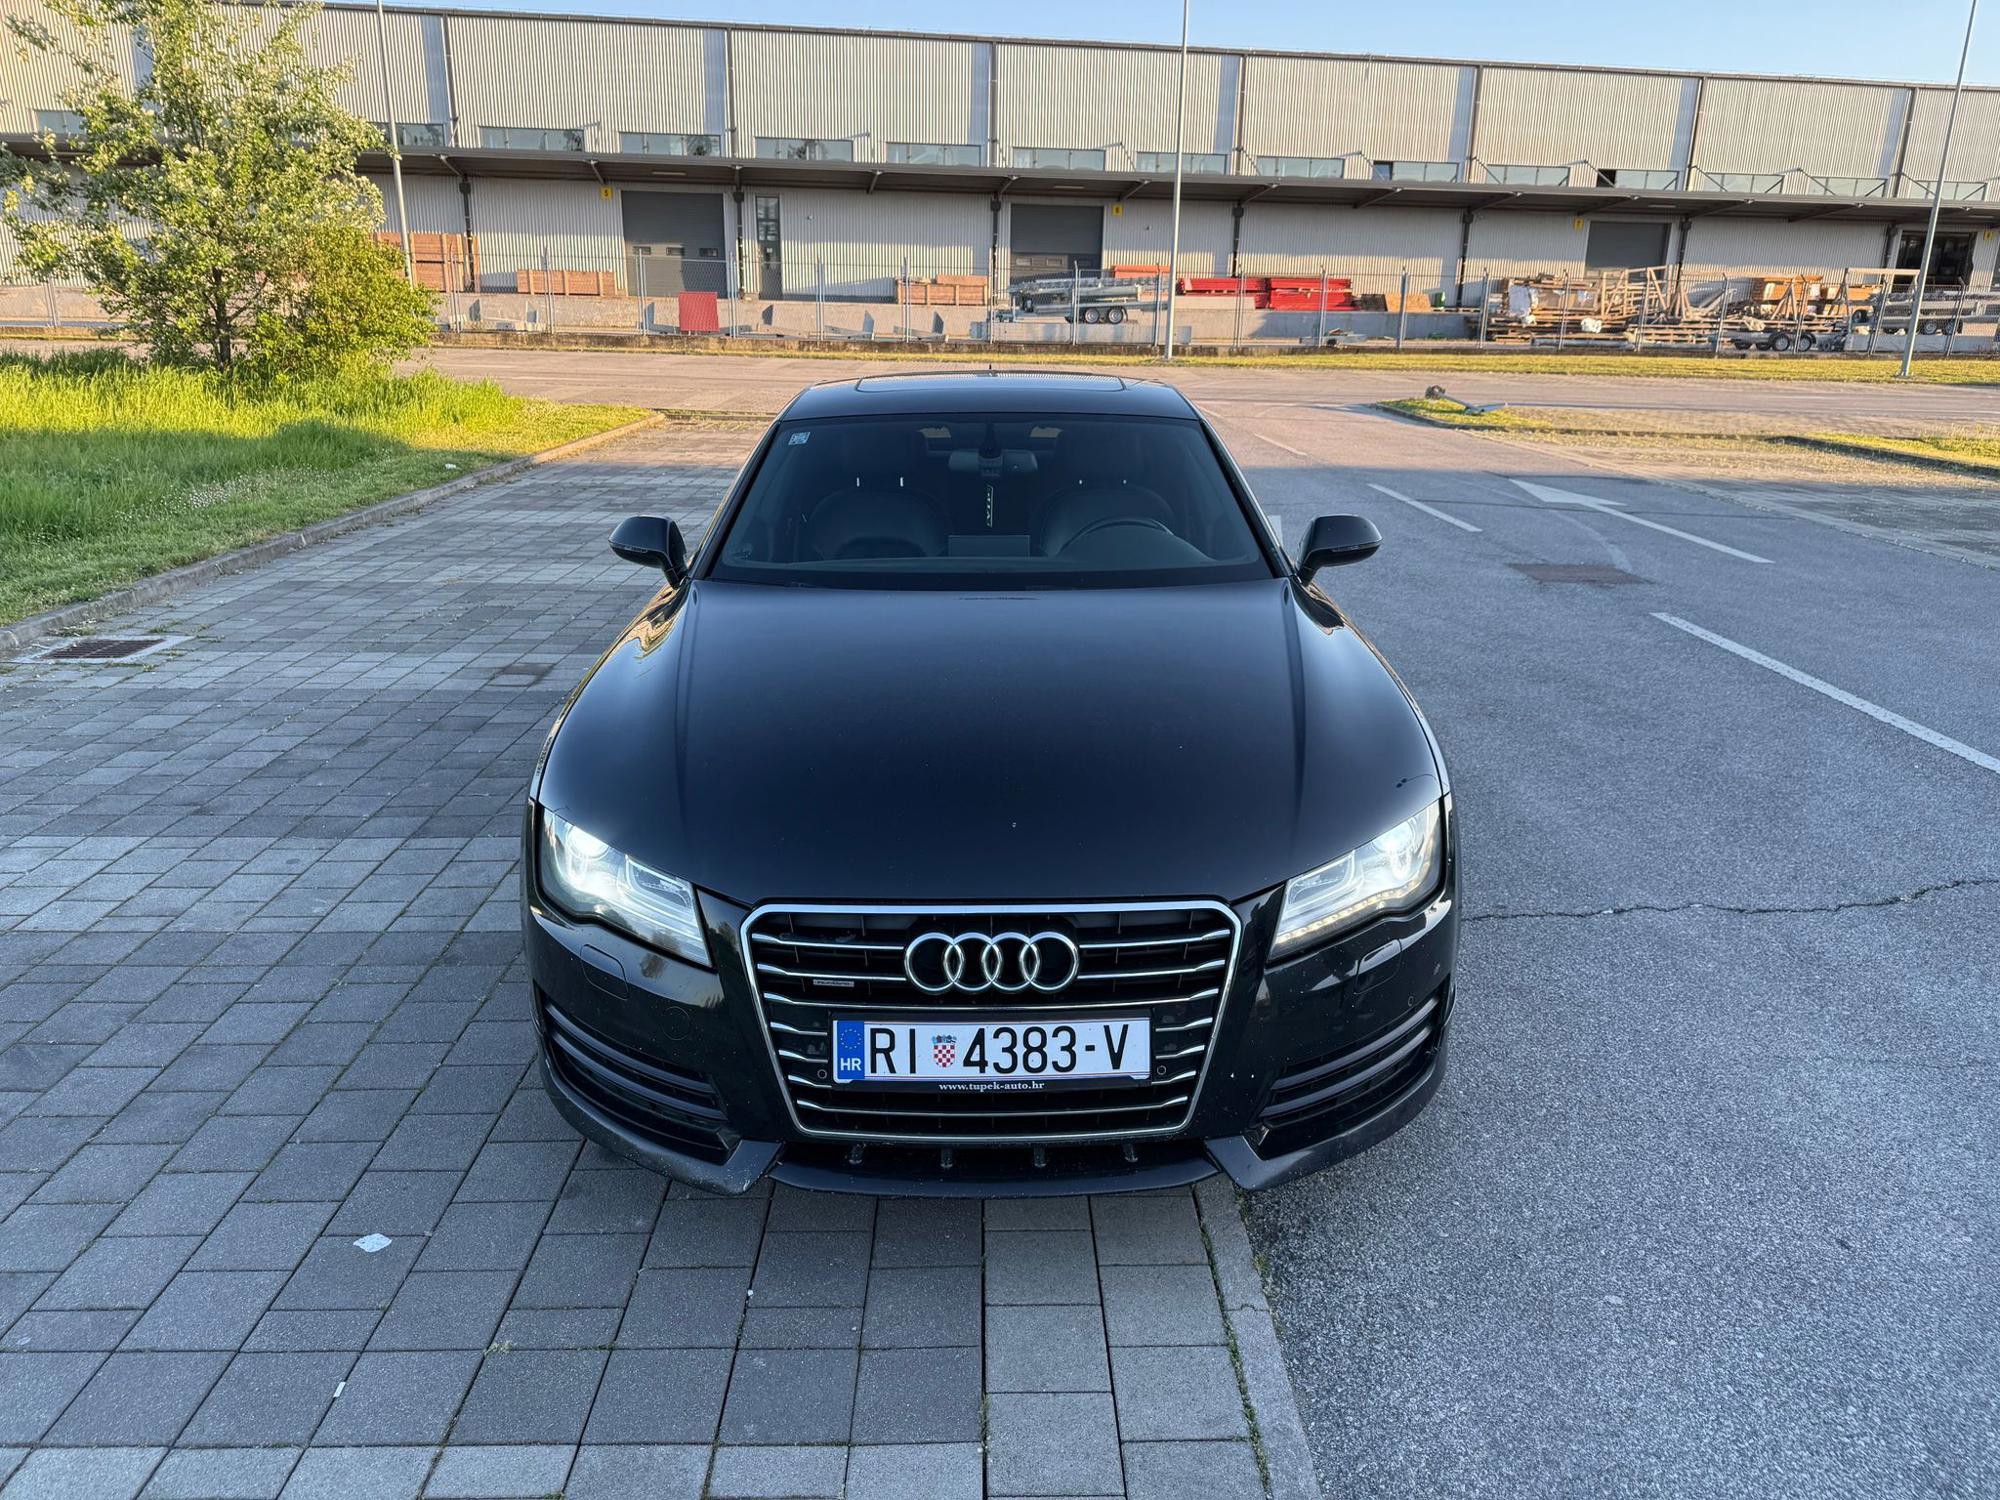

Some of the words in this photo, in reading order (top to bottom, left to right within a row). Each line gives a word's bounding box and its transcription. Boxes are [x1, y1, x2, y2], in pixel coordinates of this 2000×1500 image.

[870, 1027, 916, 1074] RI
[962, 1024, 1129, 1074] 4383-V
[840, 1057, 862, 1071] HR
[939, 1081, 1045, 1092] www.tupek-auto.hr
